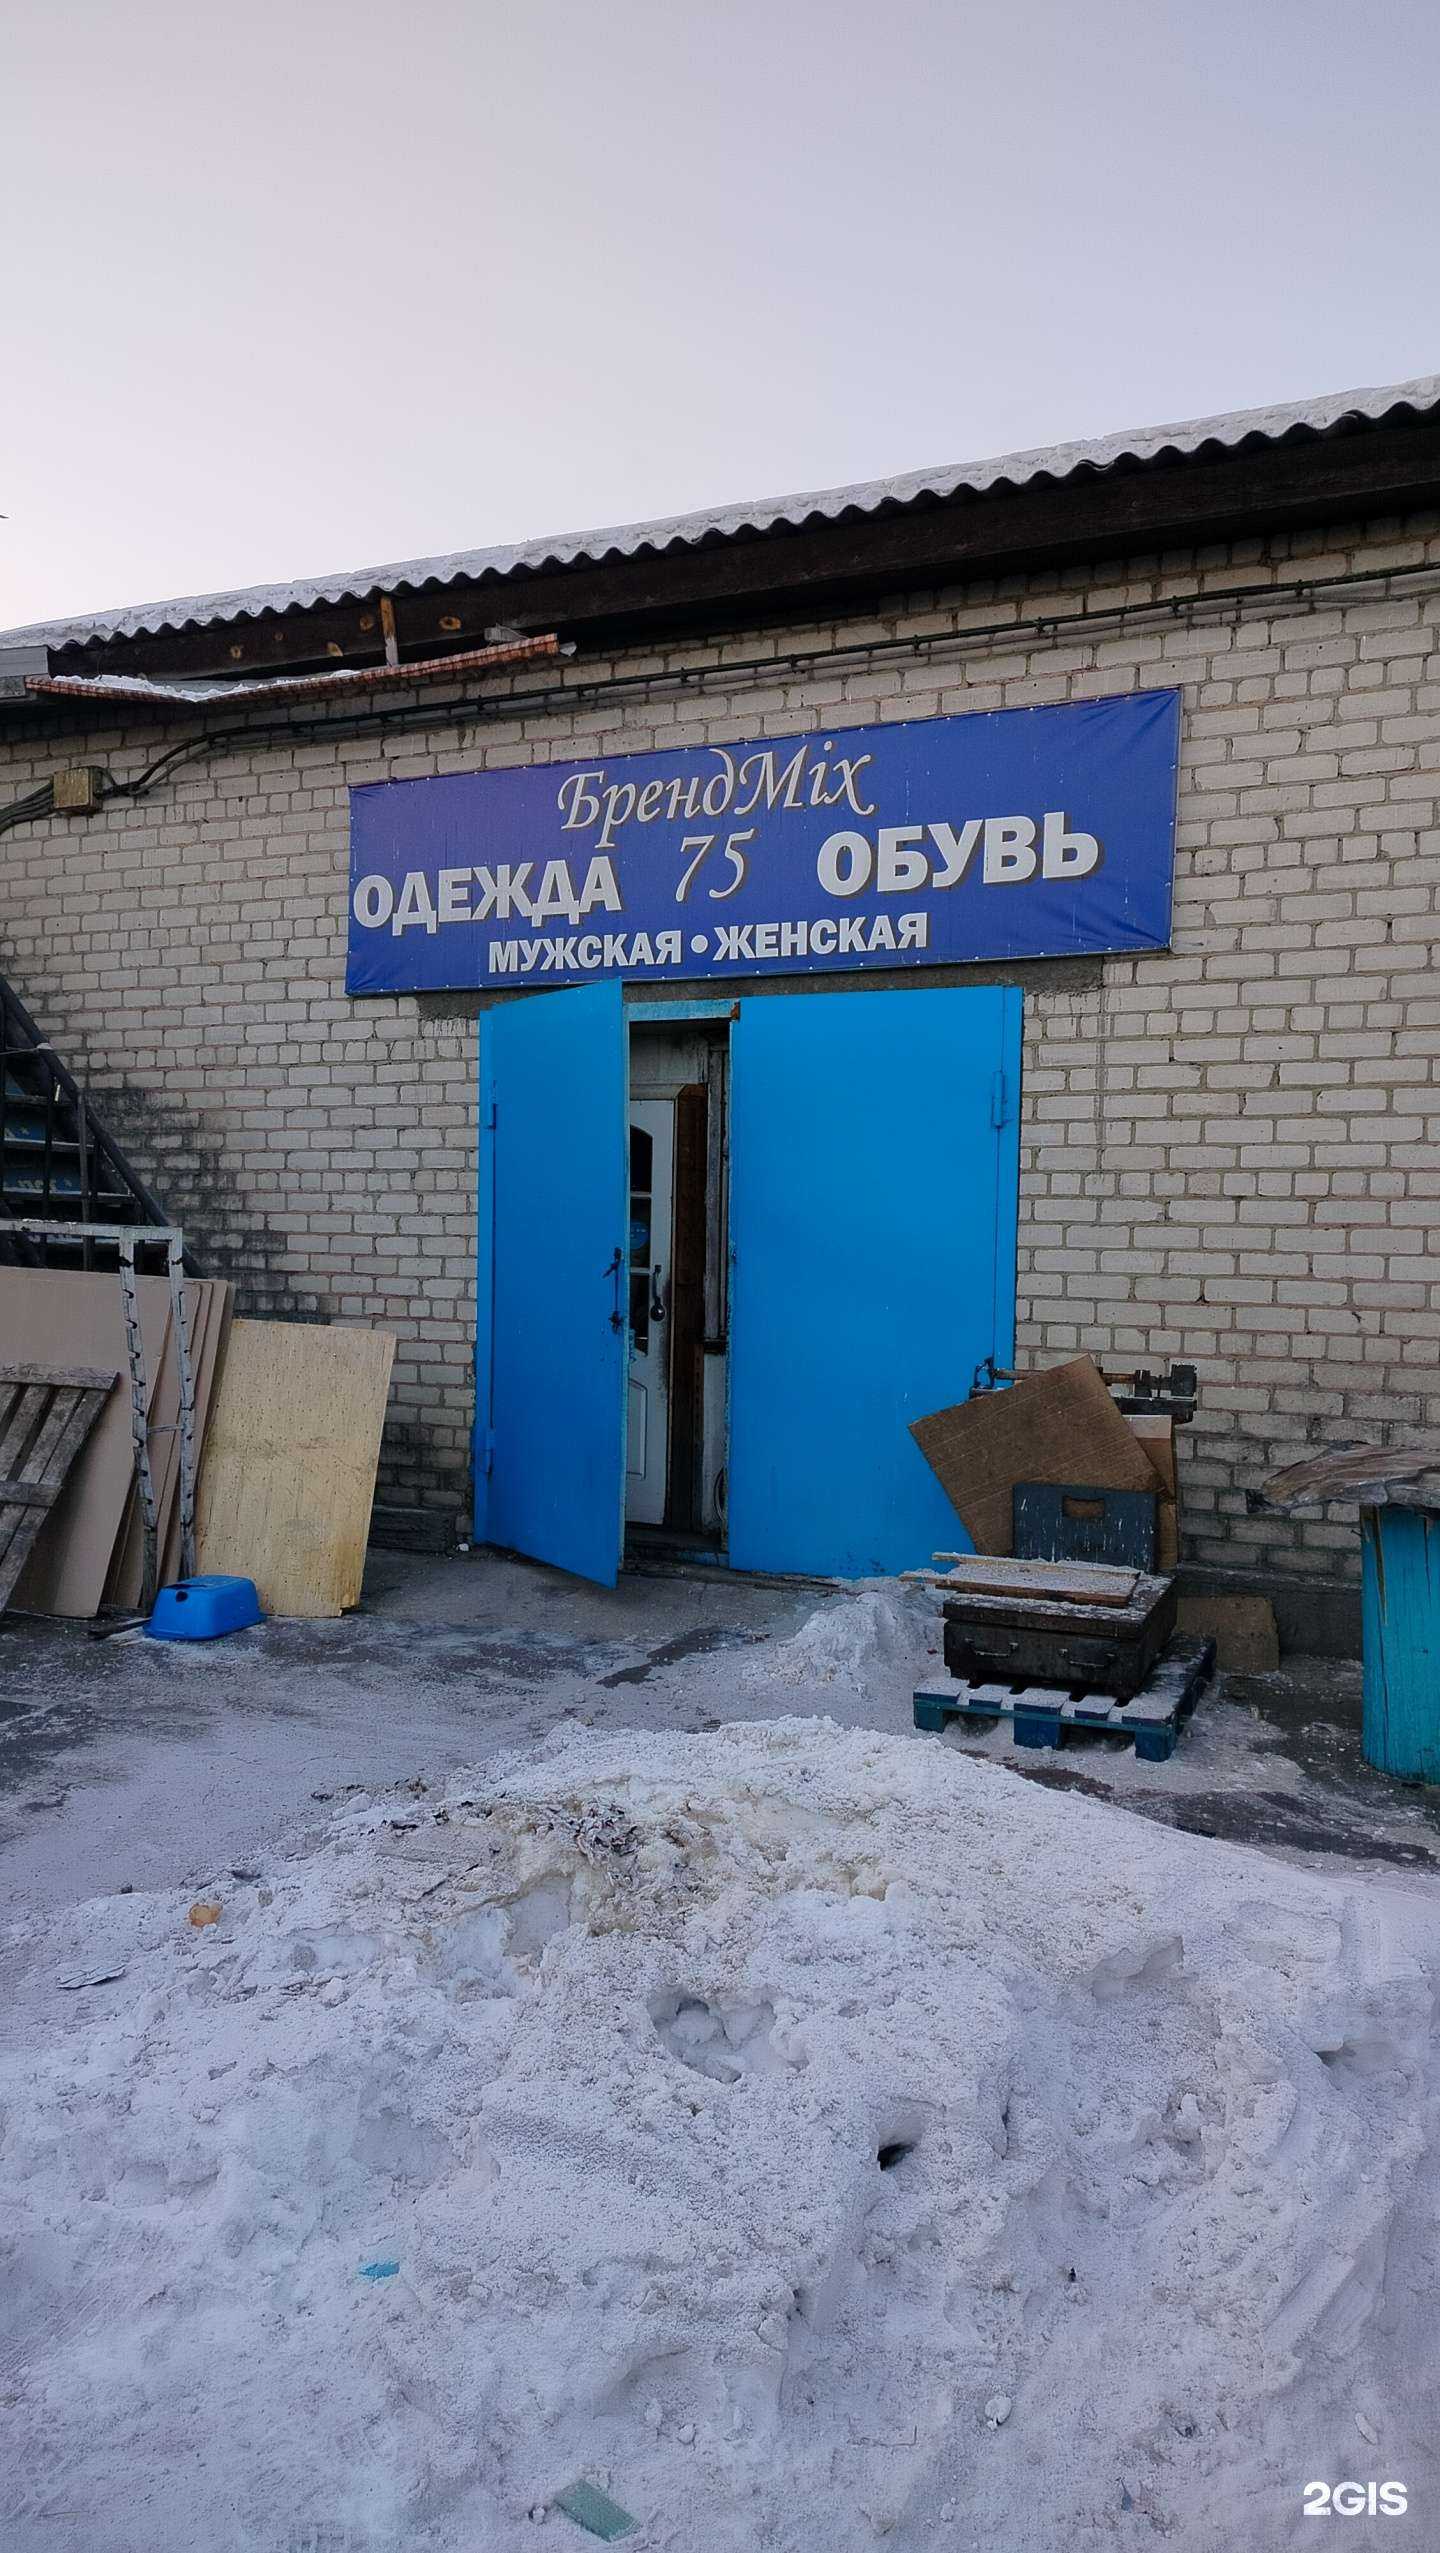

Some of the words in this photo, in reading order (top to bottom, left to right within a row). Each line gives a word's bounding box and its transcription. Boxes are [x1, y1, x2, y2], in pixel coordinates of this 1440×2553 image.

[675, 828, 755, 902] 75
[816, 811, 1100, 897] ОБУВЬ
[352, 856, 622, 937] ОДЕЖДА
[487, 931, 682, 974] МУЖСКАЯ
[711, 911, 929, 962] ЖЕНСКАЯ
